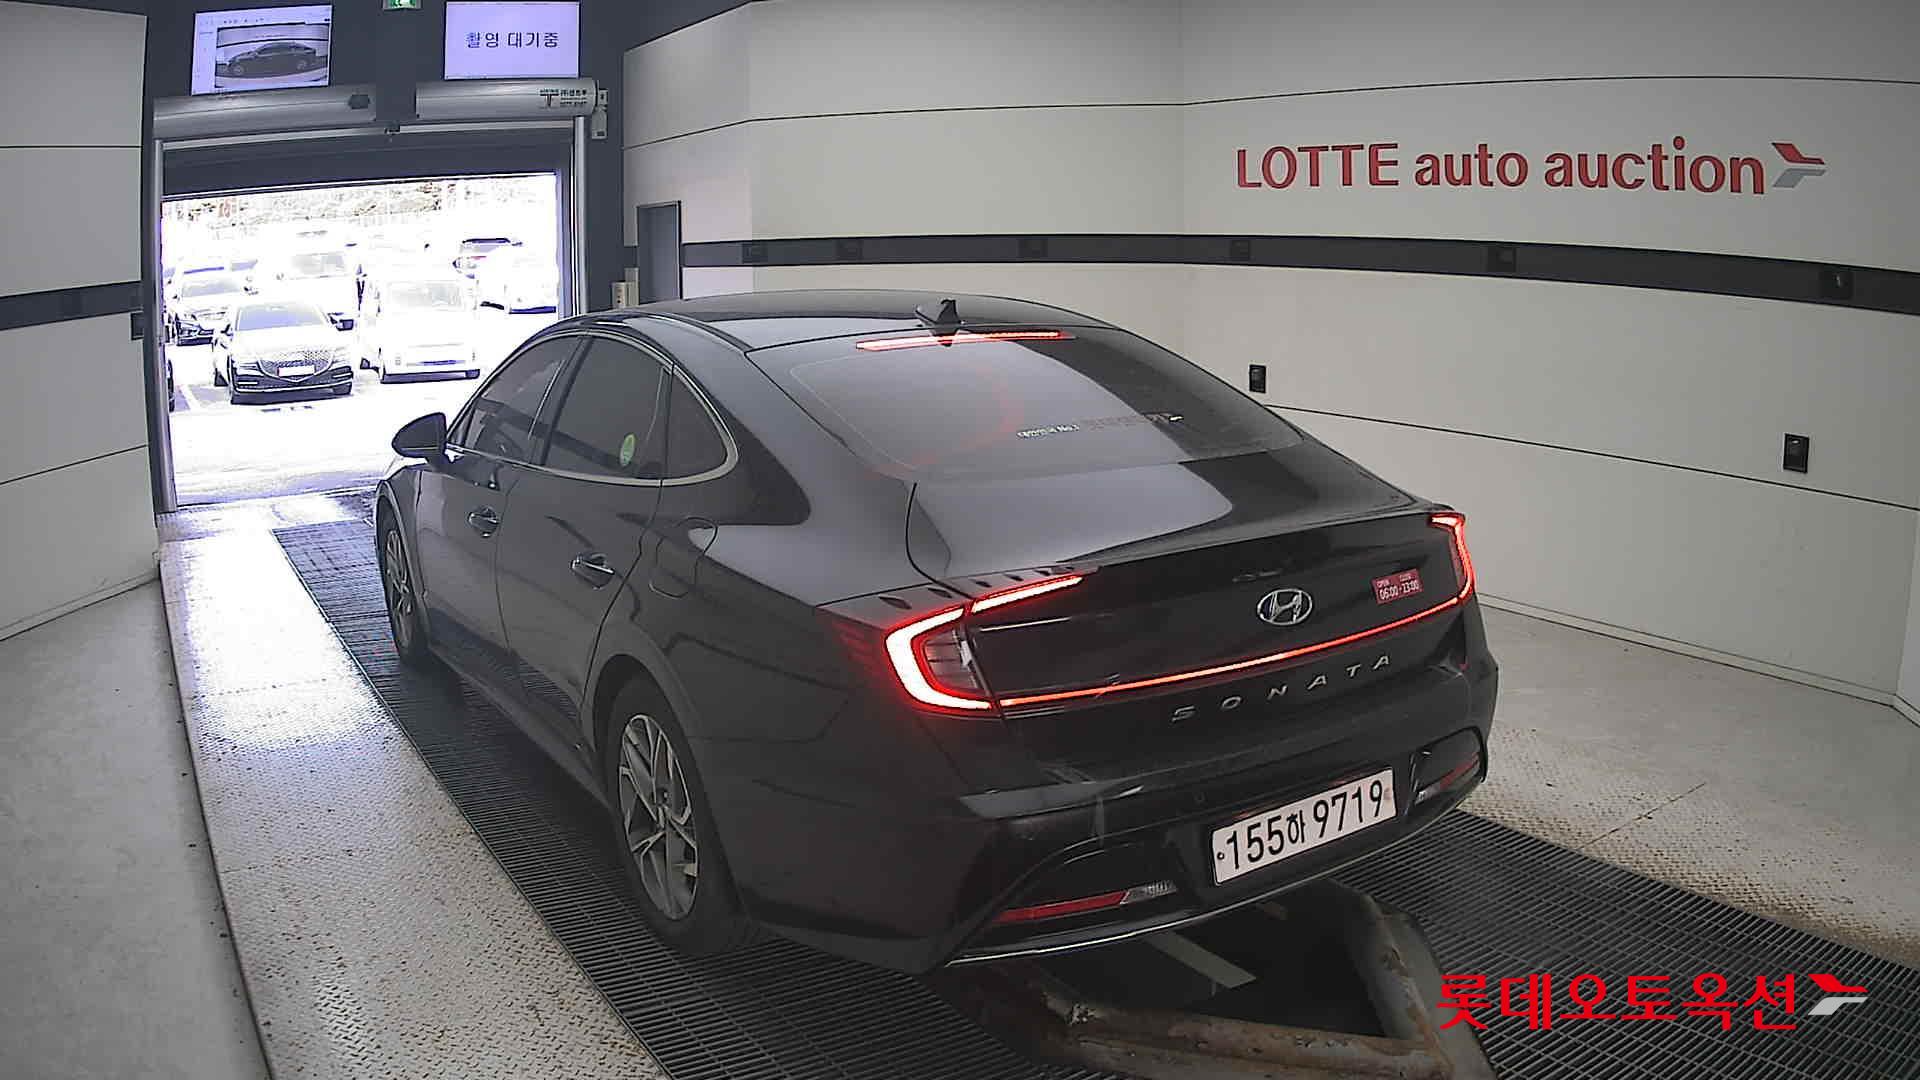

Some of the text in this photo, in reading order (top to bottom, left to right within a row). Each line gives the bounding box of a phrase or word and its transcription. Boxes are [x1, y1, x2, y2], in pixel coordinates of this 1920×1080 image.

[465, 31, 559, 49] 촬영 대기중
[1236, 136, 1765, 195] LOTTE auto auction
[1171, 655, 1390, 722] SONATA
[1313, 780, 1383, 838] 9719
